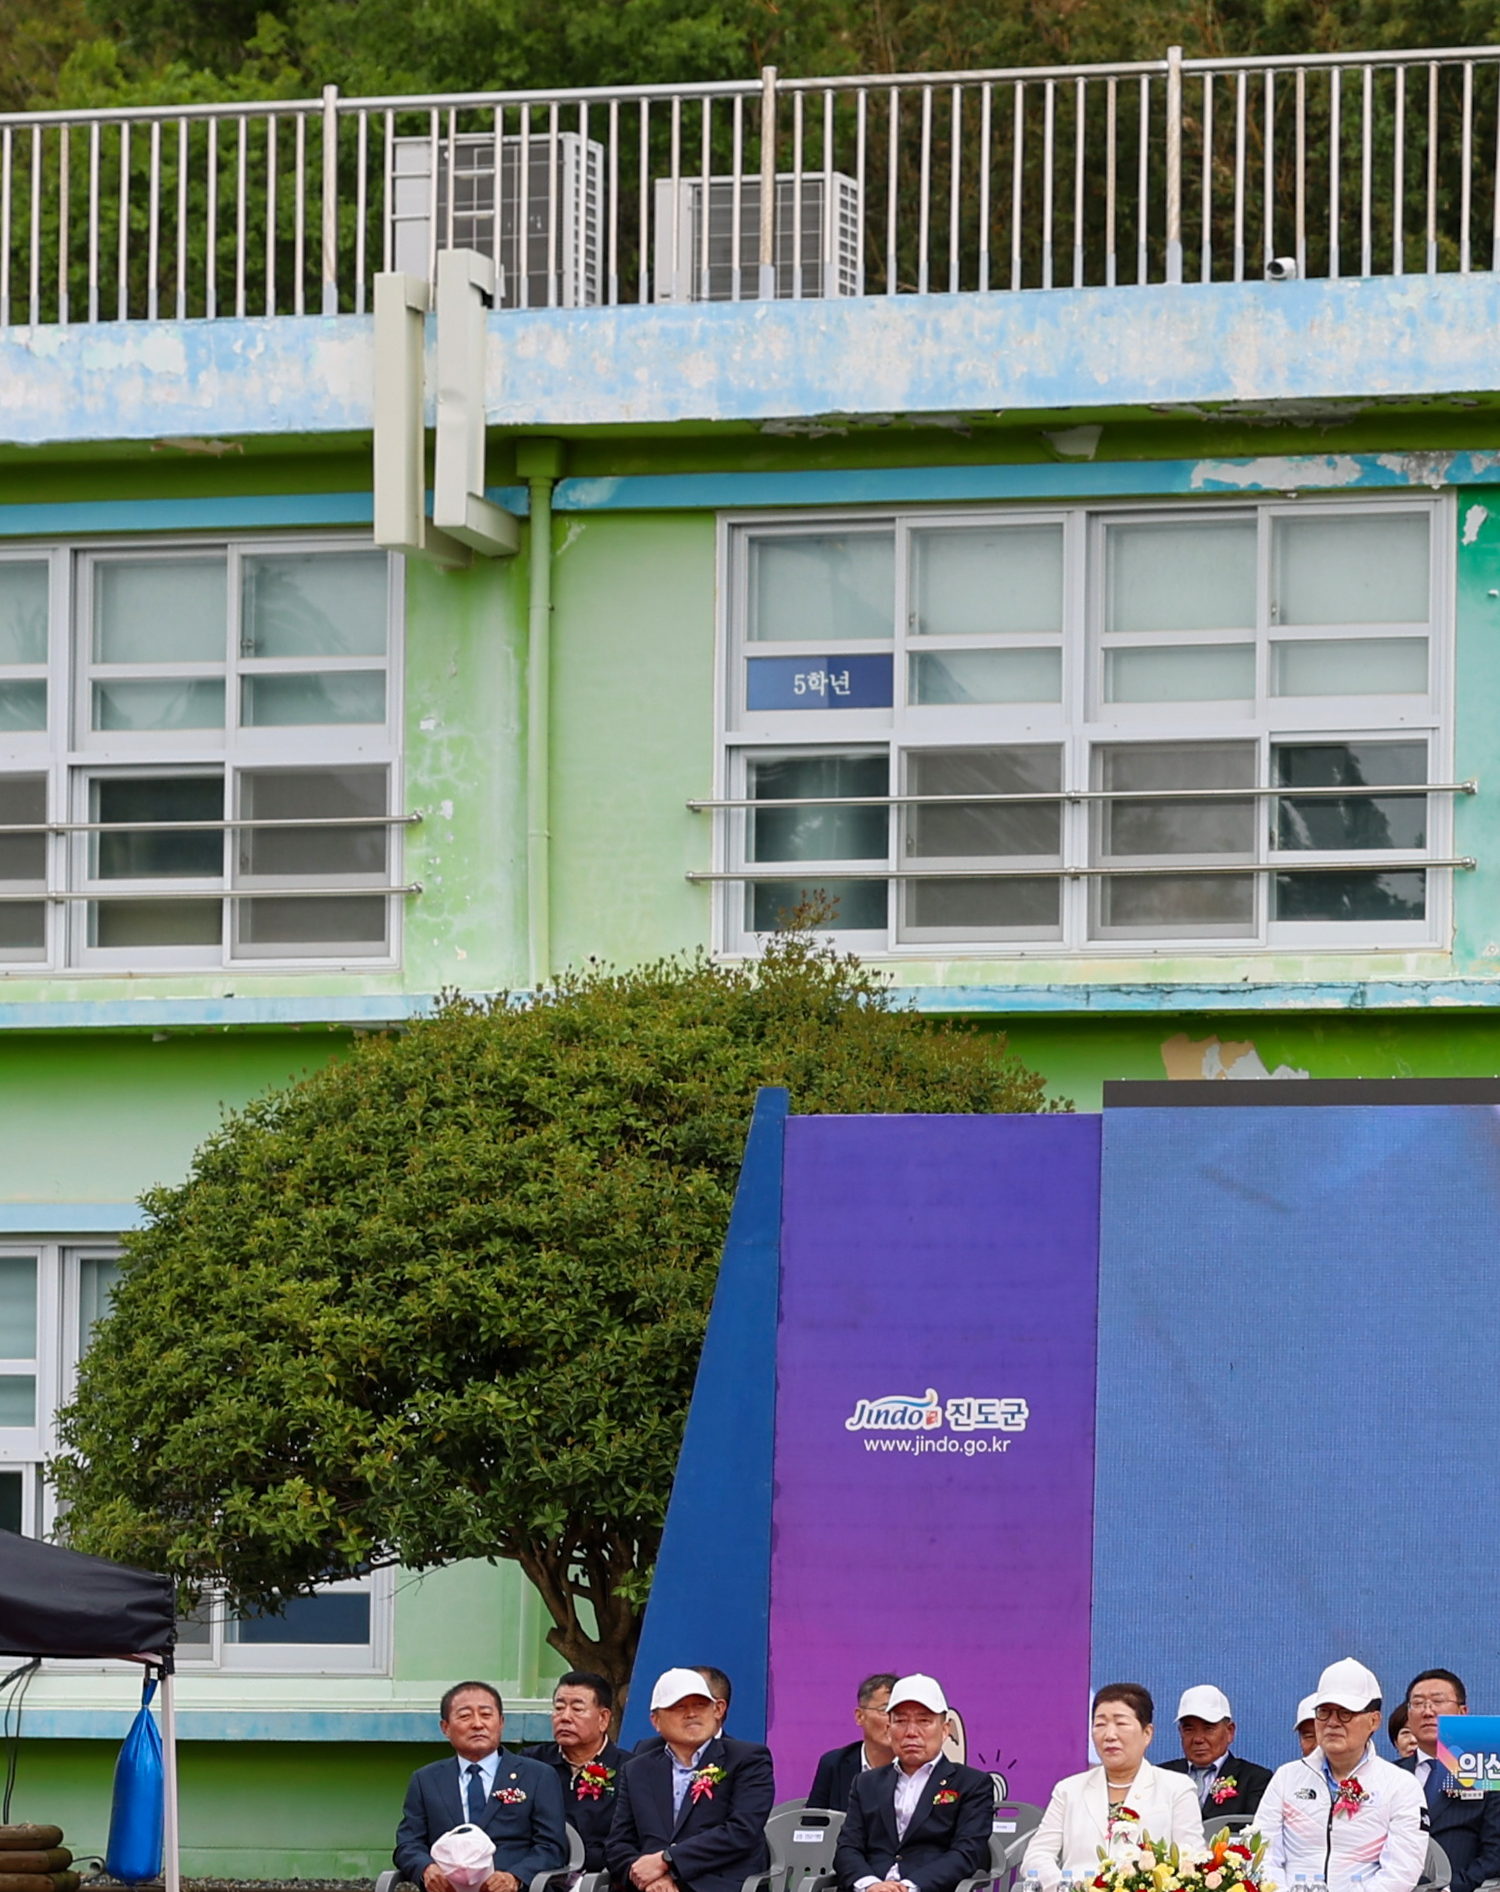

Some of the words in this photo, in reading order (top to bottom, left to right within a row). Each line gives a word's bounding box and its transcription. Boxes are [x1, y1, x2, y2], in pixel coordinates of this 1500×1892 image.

[793, 670, 851, 697] 5학년
[848, 1398, 926, 1428] Jindo
[949, 1401, 1026, 1428] 진도군
[863, 1435, 1012, 1457] www.jindo.go.kr
